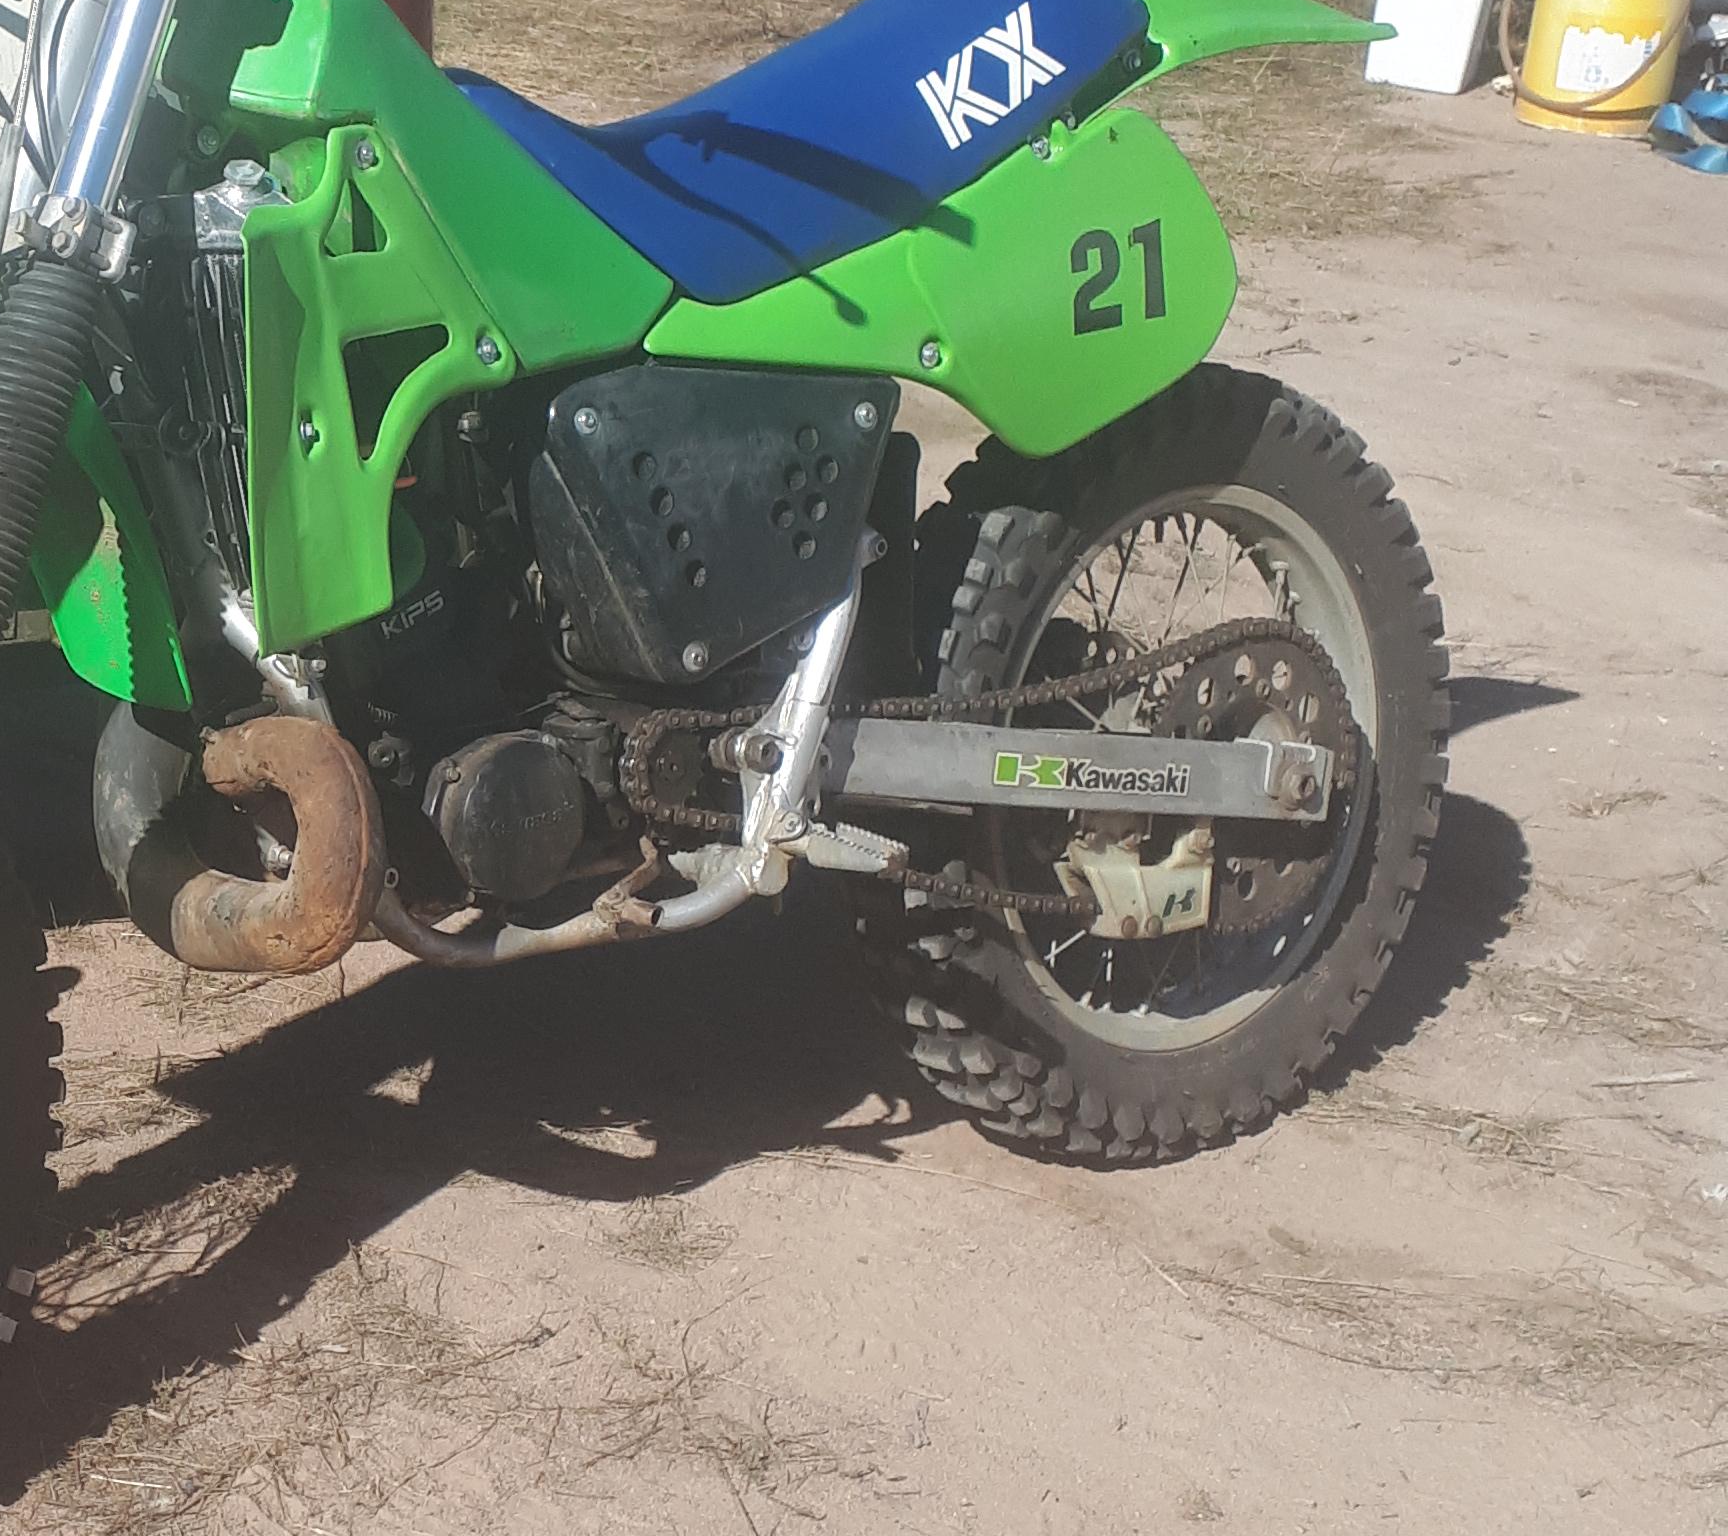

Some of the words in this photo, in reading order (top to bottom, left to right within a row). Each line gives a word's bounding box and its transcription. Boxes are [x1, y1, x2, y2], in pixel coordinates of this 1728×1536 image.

[915, 0, 1067, 151] KX
[1070, 218, 1167, 337] 21
[379, 589, 447, 640] KIPS
[1066, 759, 1190, 796] Kawasaki
